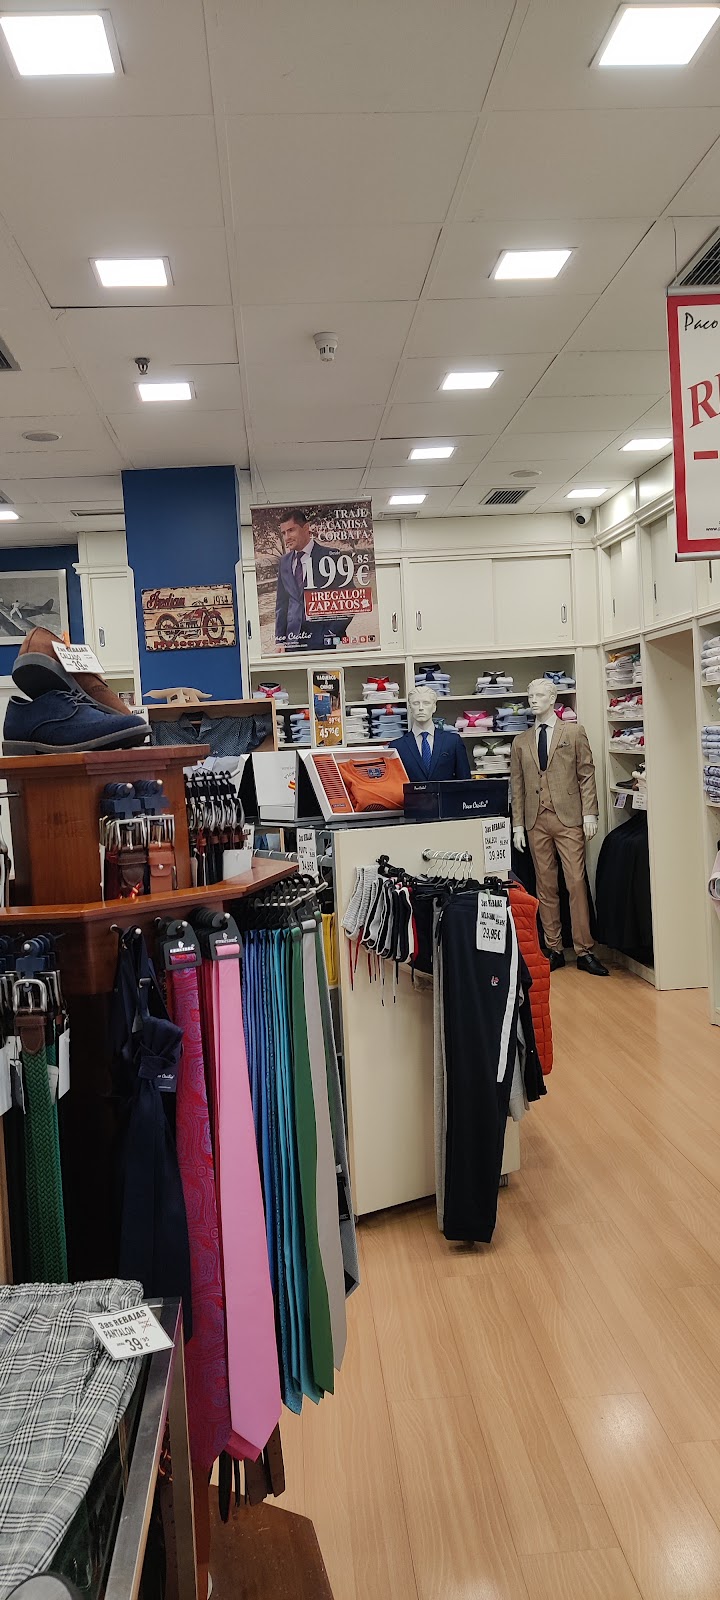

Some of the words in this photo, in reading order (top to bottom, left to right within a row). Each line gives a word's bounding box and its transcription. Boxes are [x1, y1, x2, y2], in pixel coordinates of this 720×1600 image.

[684, 312, 719, 331] Paco
[687, 373, 720, 428] R
[334, 508, 368, 519] TRAJE
[327, 519, 368, 531] CAMISA
[318, 530, 368, 541] CORBATA
[311, 589, 366, 602] ¡¡REGALO!!
[308, 599, 360, 612] ZAPATOS
[98, 1322, 114, 1330] 3as
[113, 1309, 147, 1327] REBAJAS
[103, 1325, 136, 1340] PANTALON
